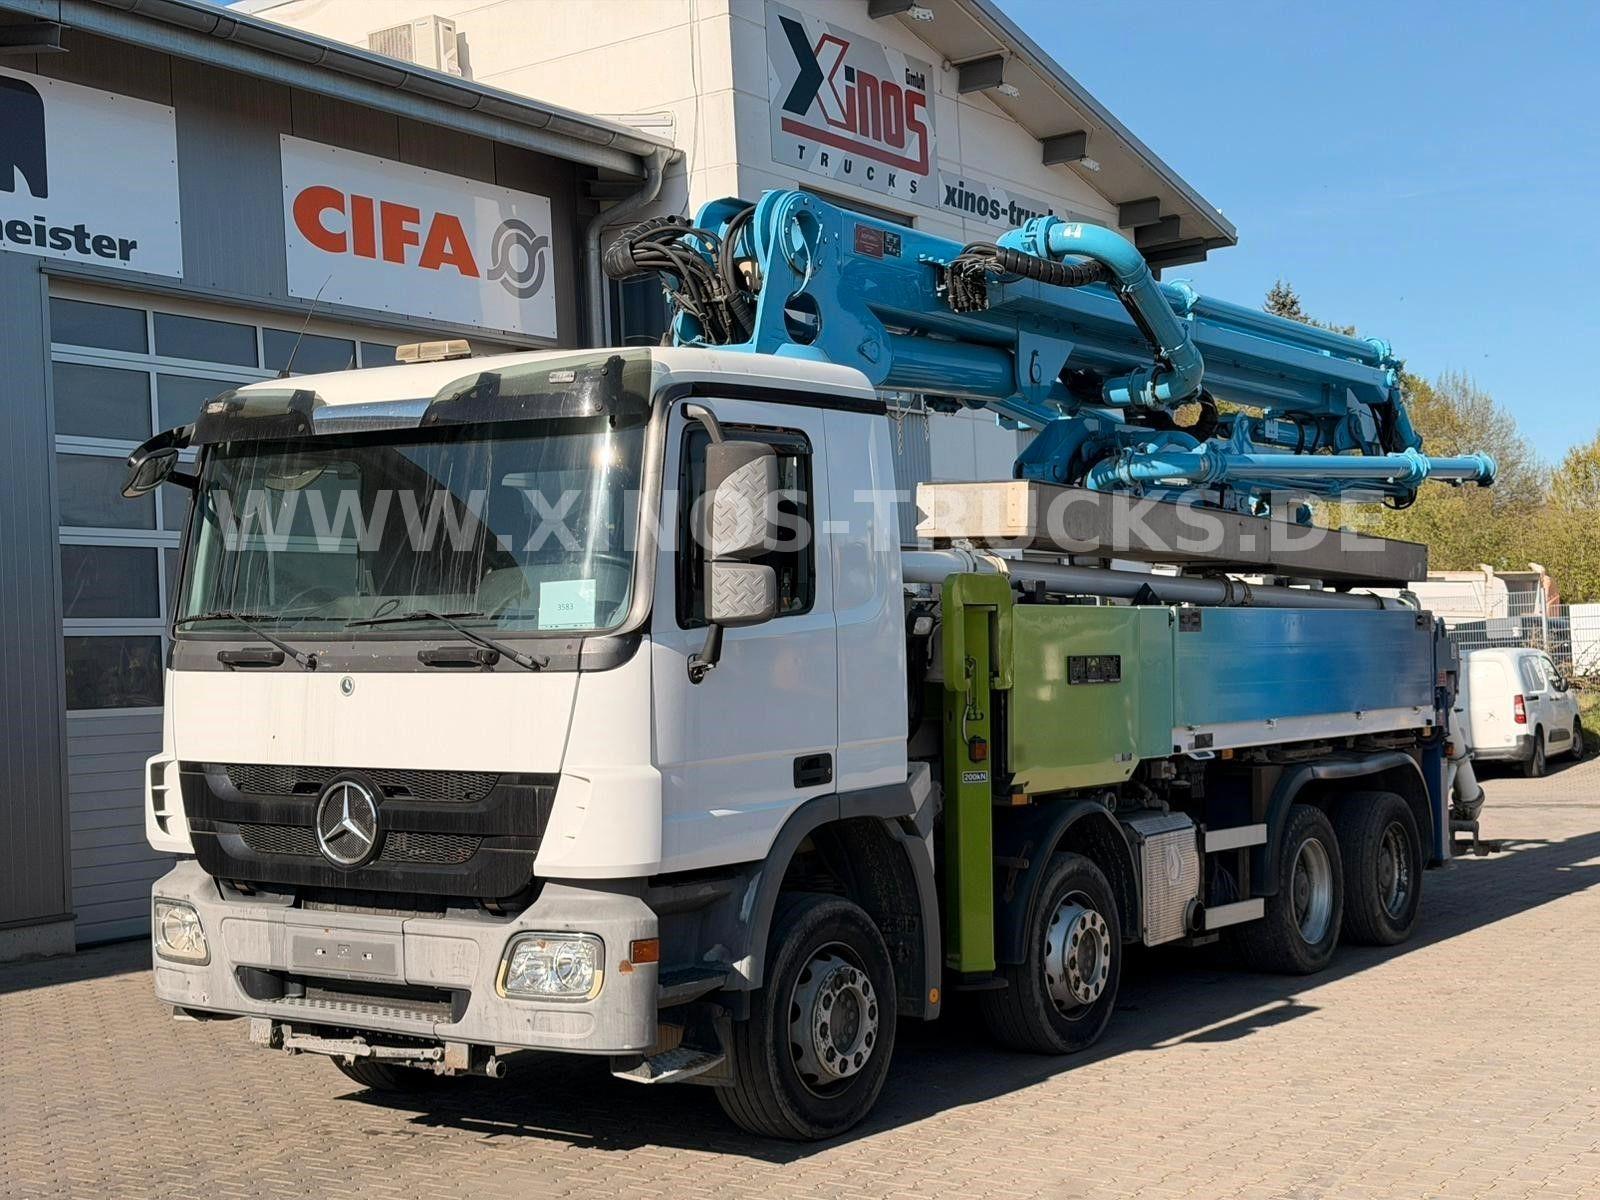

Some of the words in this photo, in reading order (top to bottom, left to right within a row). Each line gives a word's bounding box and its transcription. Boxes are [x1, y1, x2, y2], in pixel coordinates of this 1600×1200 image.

[905, 67, 926, 91] GmbH
[797, 145, 918, 194] TRUCKS
[0, 215, 138, 261] eister
[293, 185, 480, 278] CIFA
[557, 602, 574, 611] 3583
